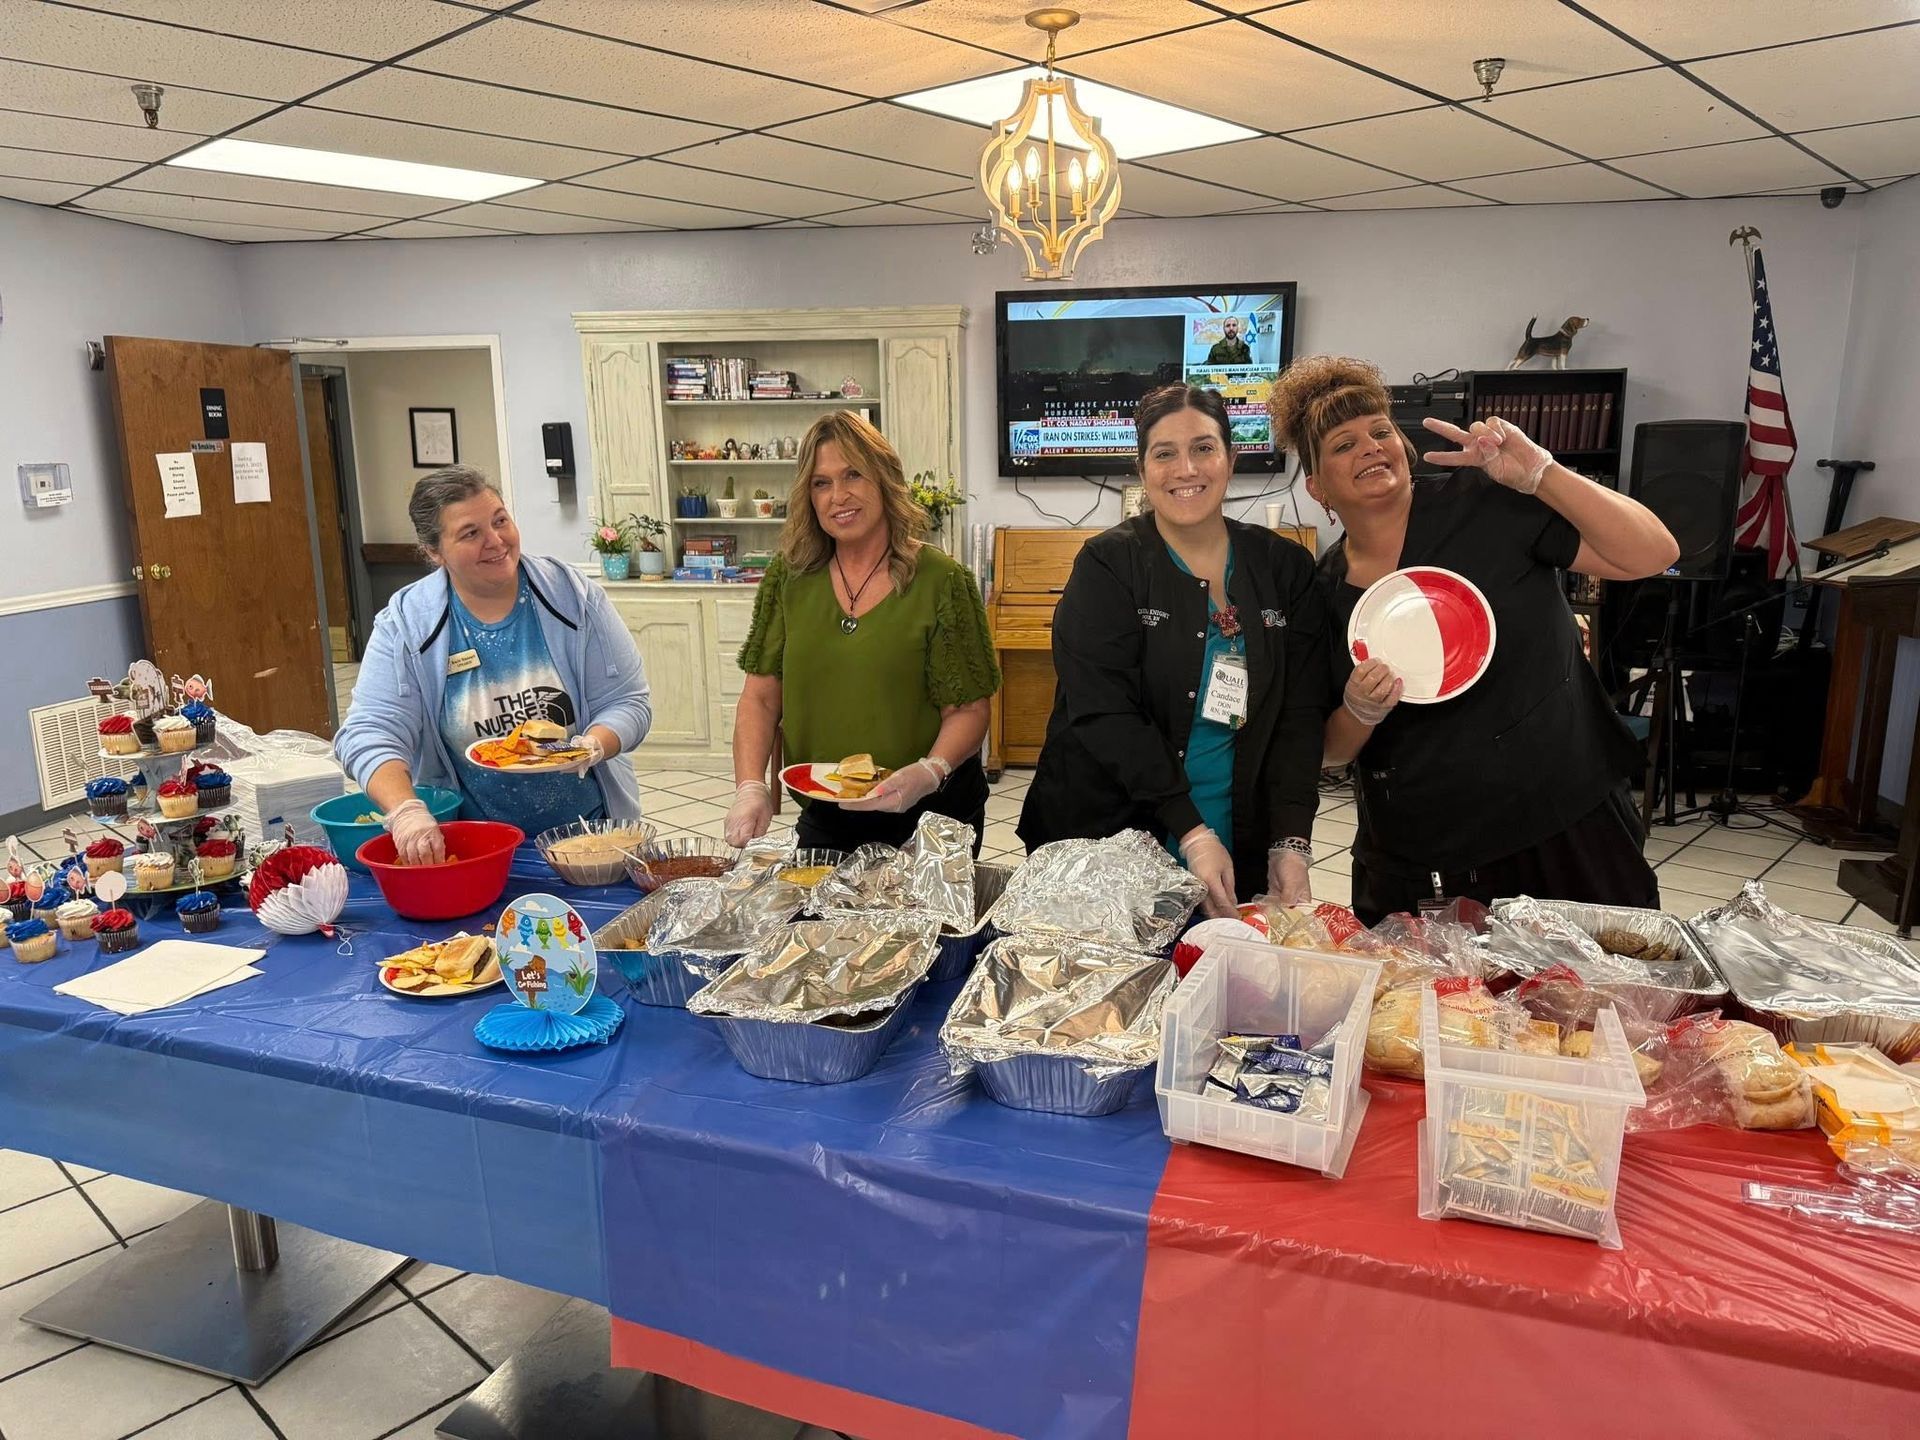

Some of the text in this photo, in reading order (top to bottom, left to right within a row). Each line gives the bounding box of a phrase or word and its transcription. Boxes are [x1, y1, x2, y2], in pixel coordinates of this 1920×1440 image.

[1023, 434, 1038, 442] FOX
[1044, 432, 1059, 441] IRAN
[1061, 432, 1072, 441] ON
[1073, 431, 1101, 441] STRIKES:
[1103, 431, 1117, 440] WILL
[494, 688, 532, 713] THE
[1211, 690, 1241, 704] Candace
[474, 707, 537, 737] NURSE
[521, 970, 541, 980] Let's
[527, 981, 546, 989] Fishing
